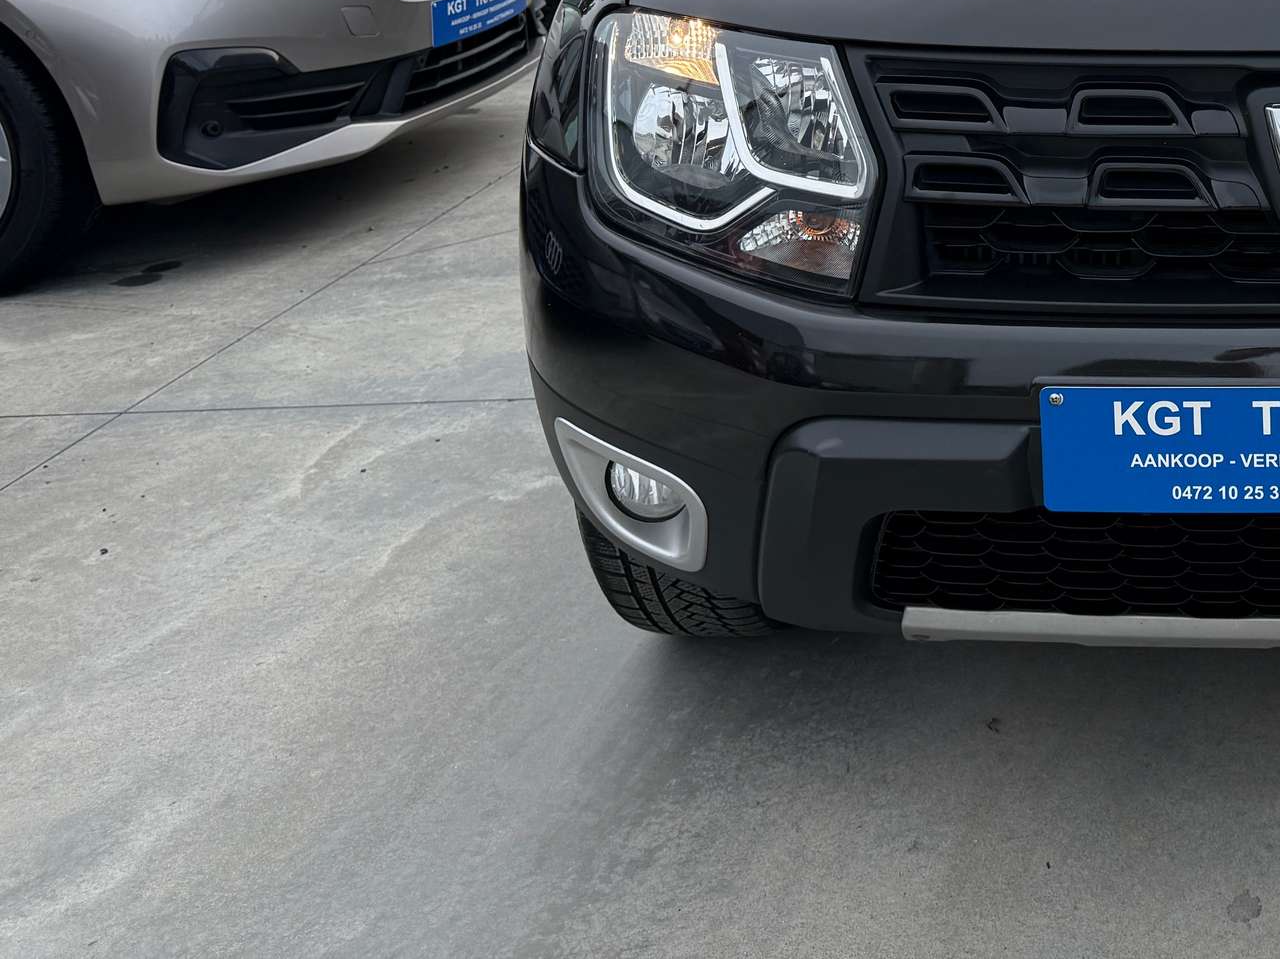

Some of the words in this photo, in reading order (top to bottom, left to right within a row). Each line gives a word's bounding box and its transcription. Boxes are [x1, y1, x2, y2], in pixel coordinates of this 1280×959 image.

[1113, 400, 1211, 436] KGT
[1130, 453, 1224, 468] AANKOOP
[1172, 486, 1213, 500] 0472
[1218, 486, 1238, 500] 10
[1243, 485, 1264, 500] 25
